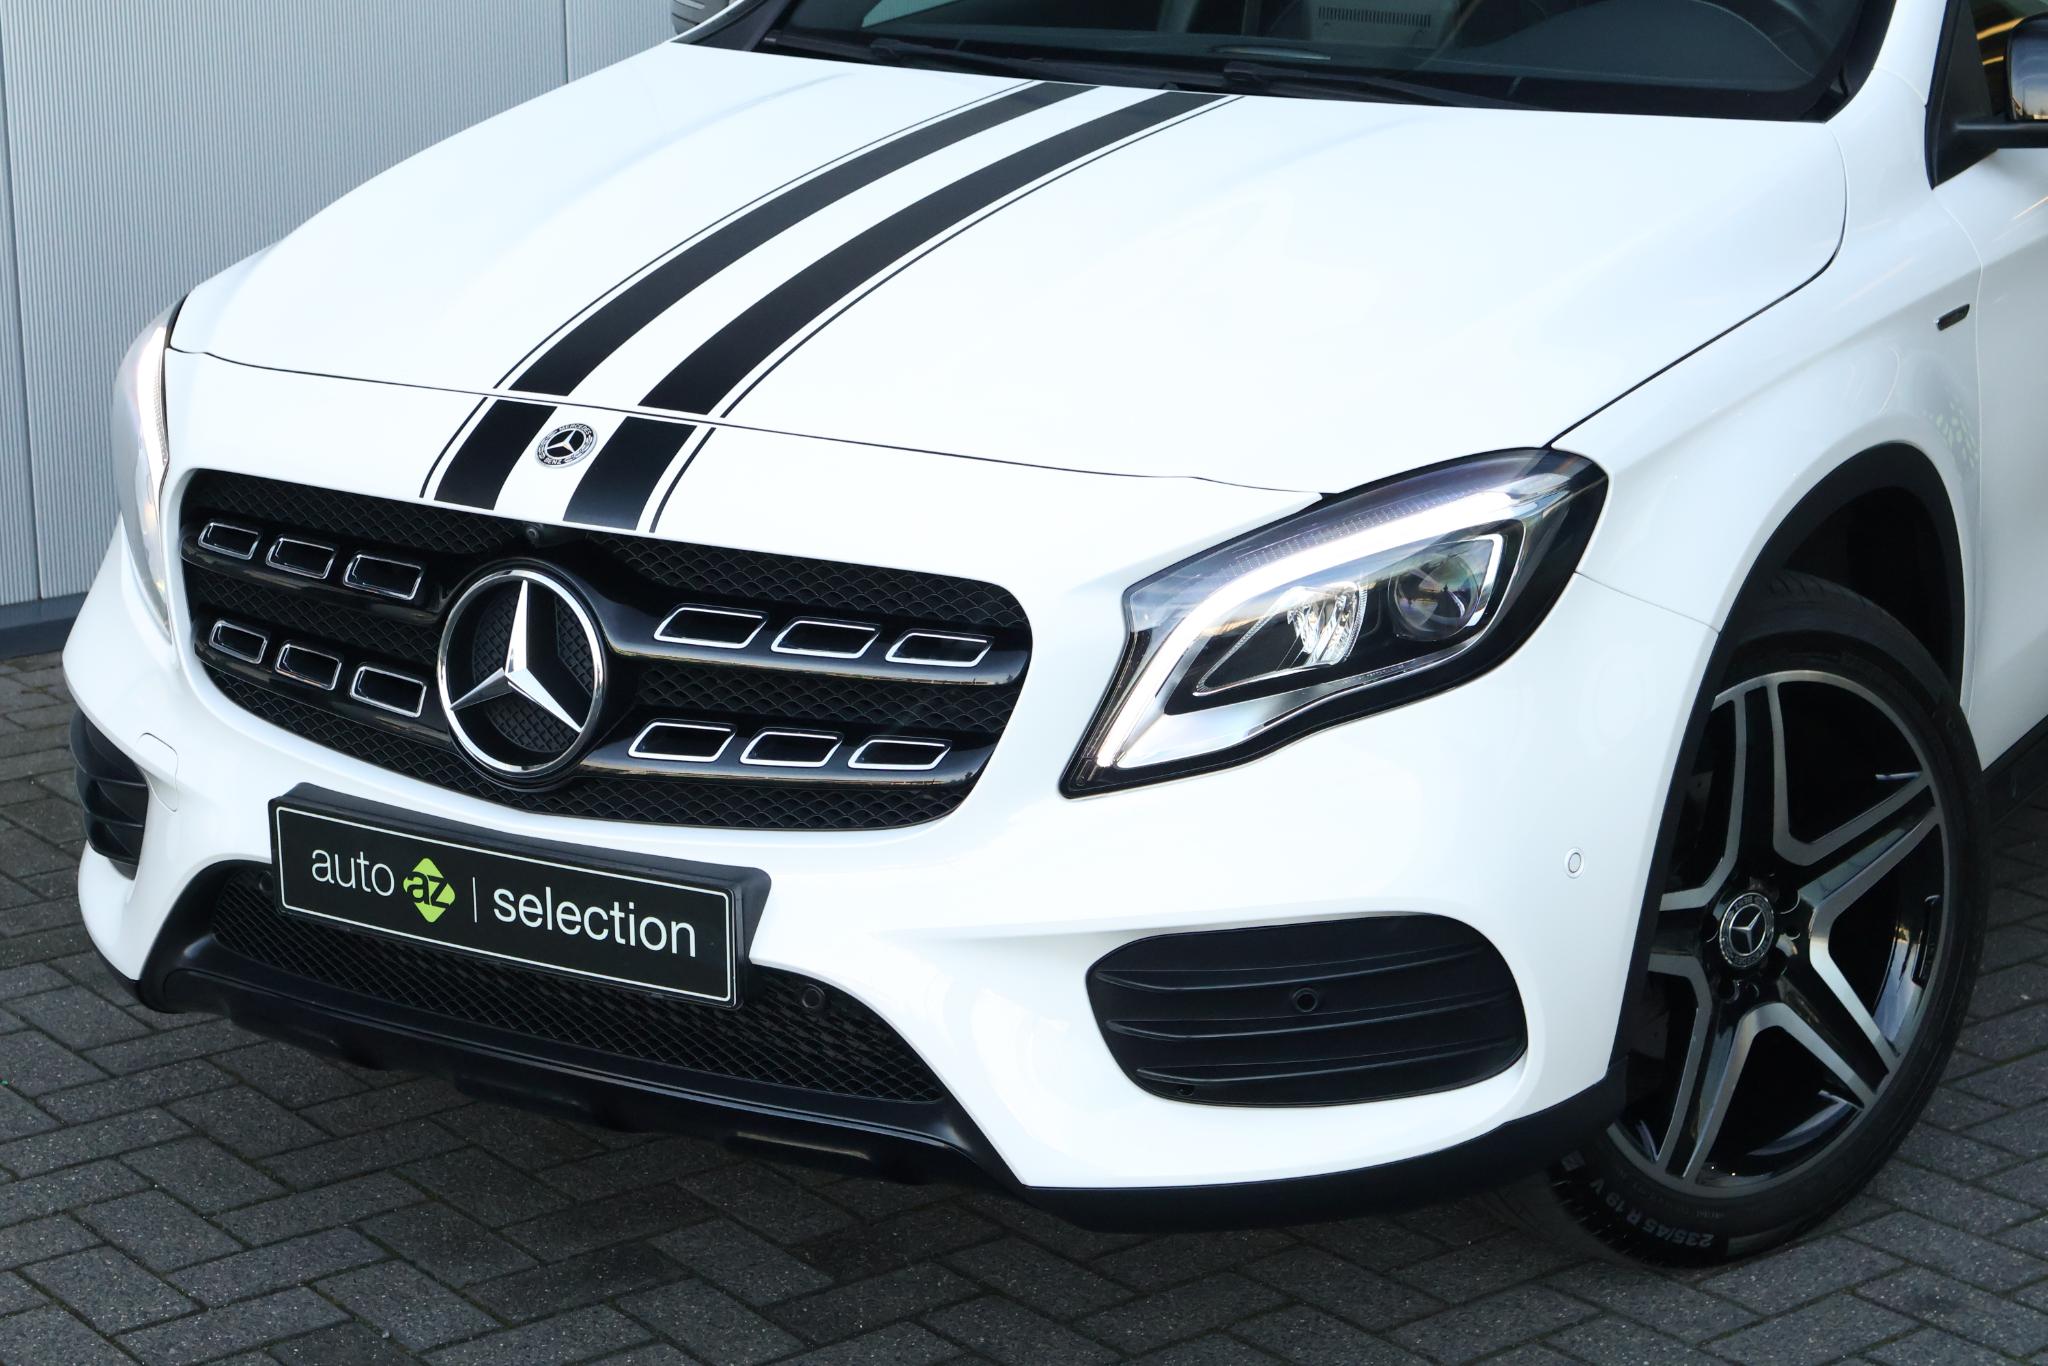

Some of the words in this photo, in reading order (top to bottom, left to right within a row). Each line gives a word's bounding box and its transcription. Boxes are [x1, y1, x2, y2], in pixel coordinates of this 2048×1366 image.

[311, 848, 395, 897] auto
[493, 886, 697, 958] selection
[1643, 1217, 1715, 1247] 235/45
